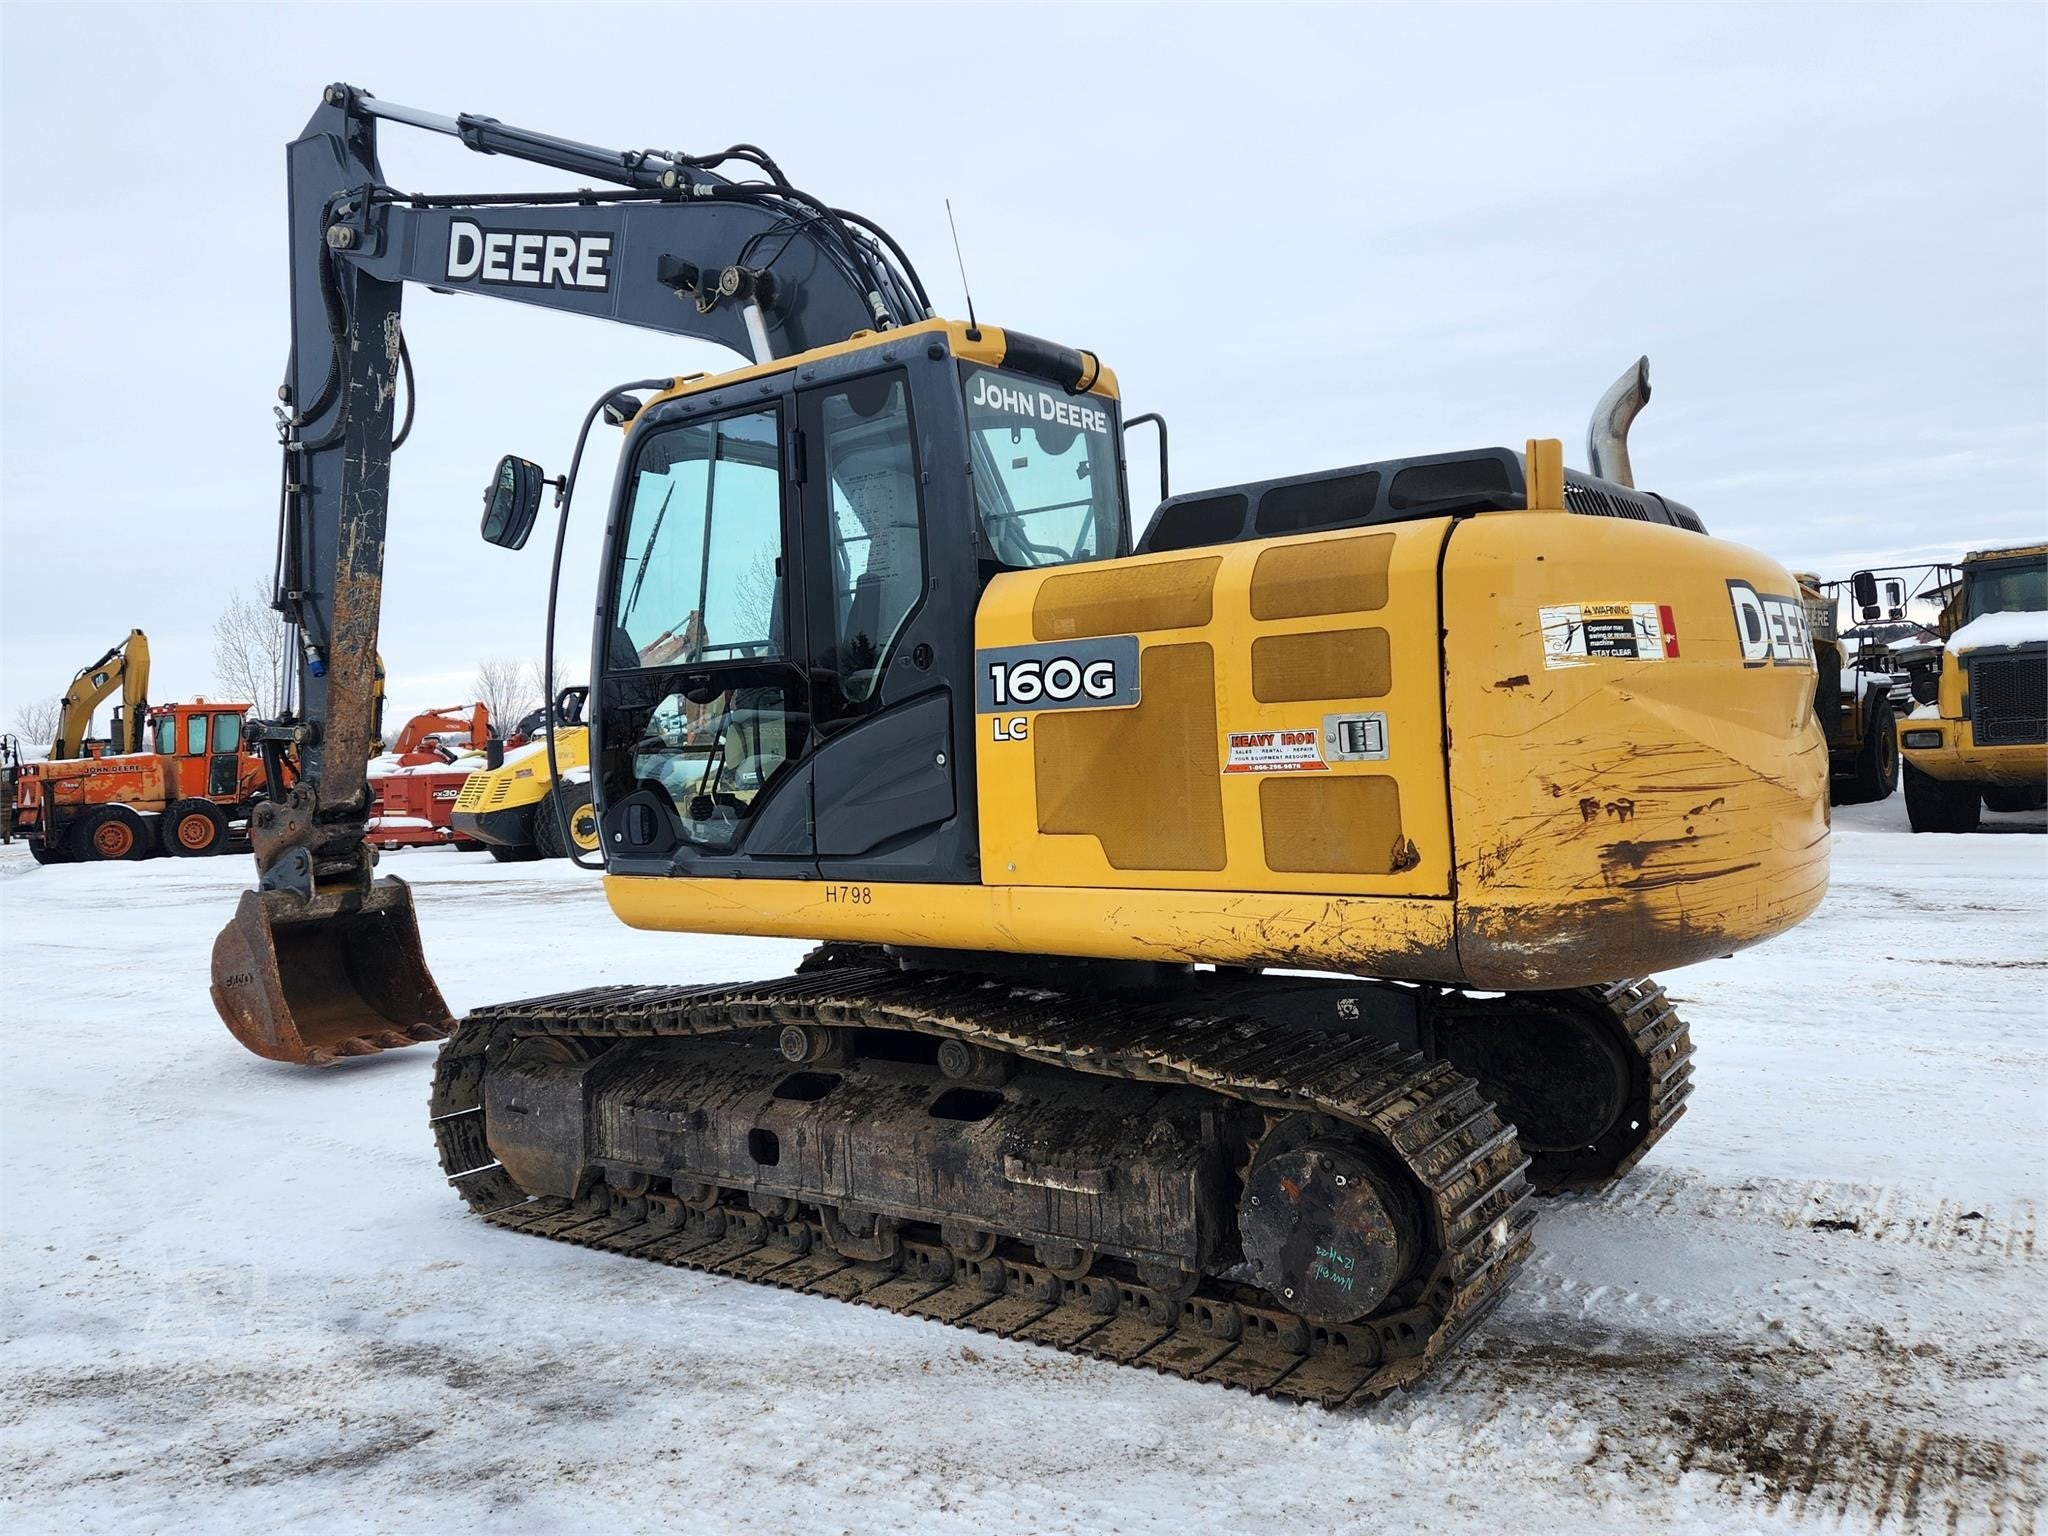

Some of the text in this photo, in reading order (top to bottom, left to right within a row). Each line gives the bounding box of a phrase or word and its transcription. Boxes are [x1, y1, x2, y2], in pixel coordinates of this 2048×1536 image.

[448, 222, 611, 287] DEERE
[974, 377, 1107, 434] JOHN DEERE
[1592, 605, 1630, 615] WARNING
[1729, 585, 1815, 662] DEER
[990, 657, 1116, 704] 160G
[994, 717, 1028, 741] LC
[1231, 731, 1315, 748] HEAVY IRON
[826, 885, 872, 905] H798
